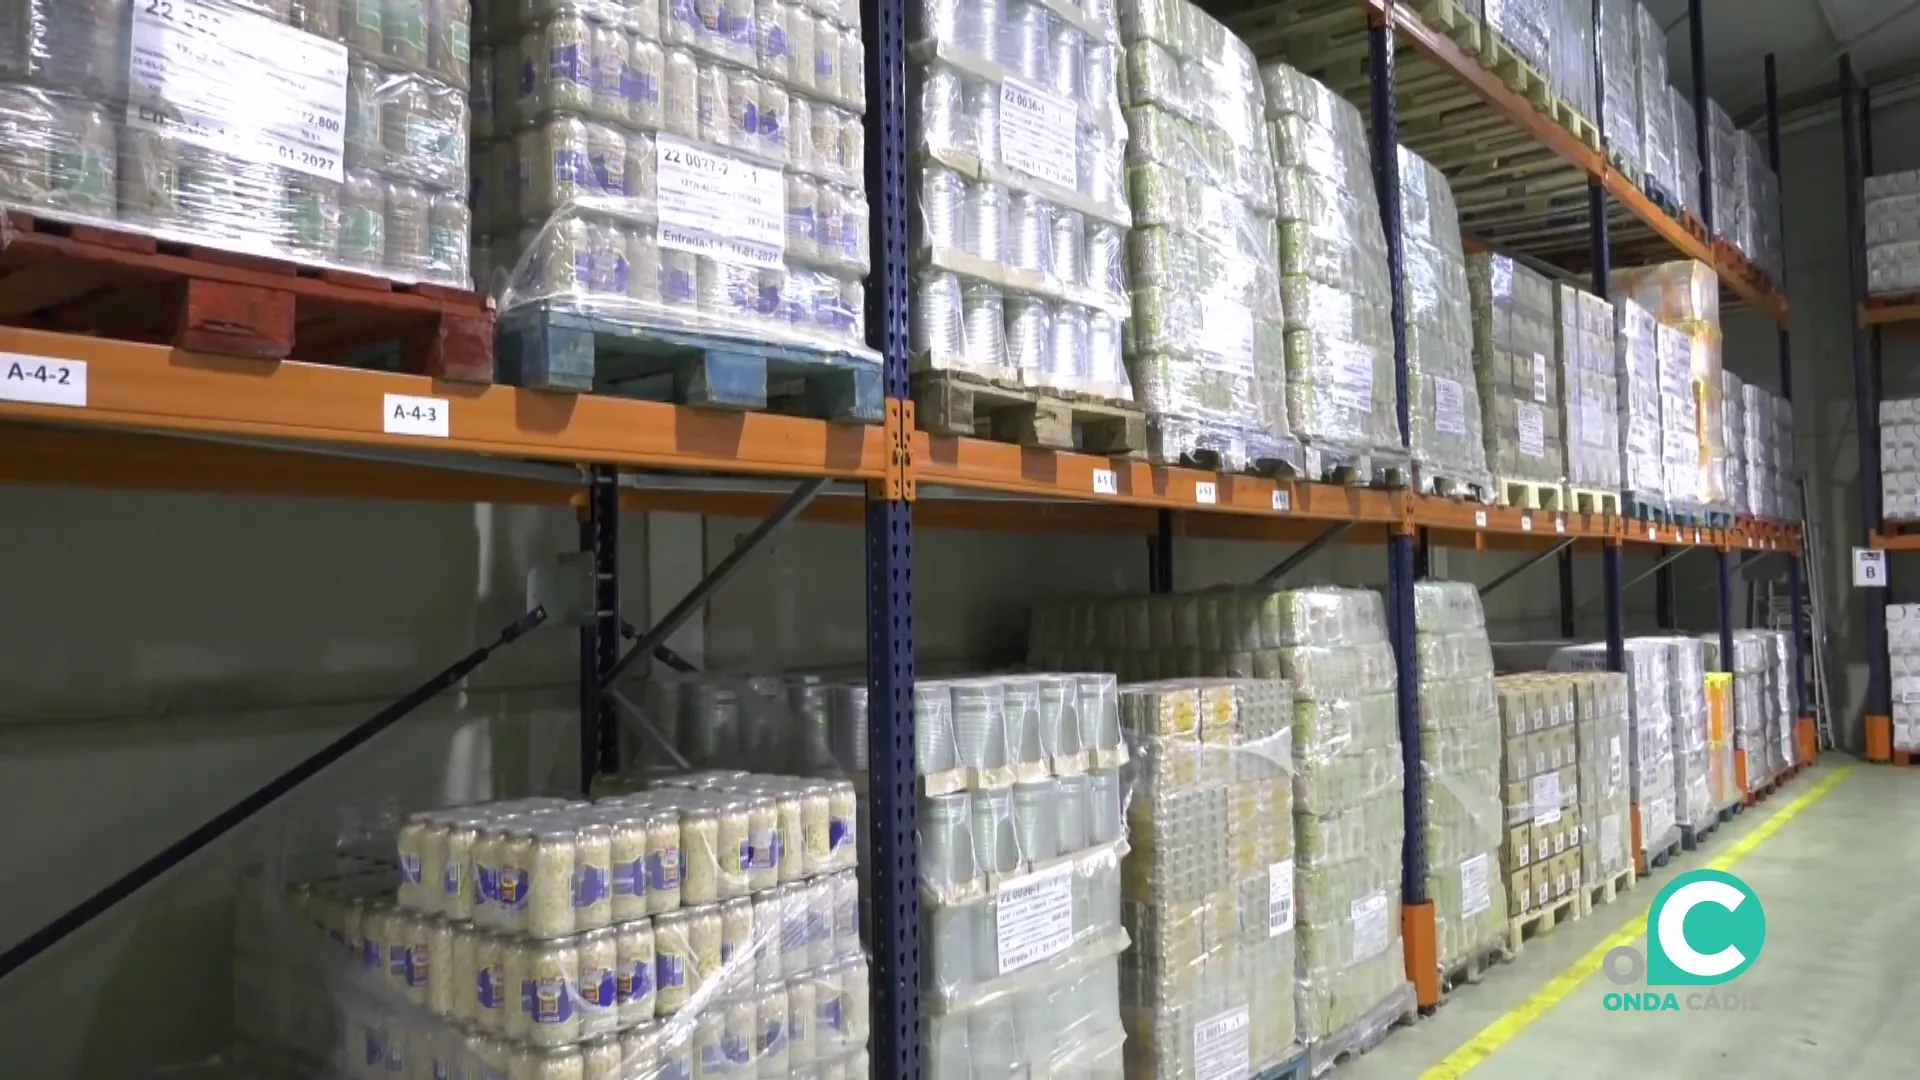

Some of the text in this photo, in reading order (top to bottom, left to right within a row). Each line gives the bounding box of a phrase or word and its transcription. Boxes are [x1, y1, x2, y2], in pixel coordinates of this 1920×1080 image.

[663, 147, 681, 164] 22
[7, 362, 71, 385] A-4-2
[394, 404, 437, 422] A-4-3
[1866, 566, 1876, 579] B
